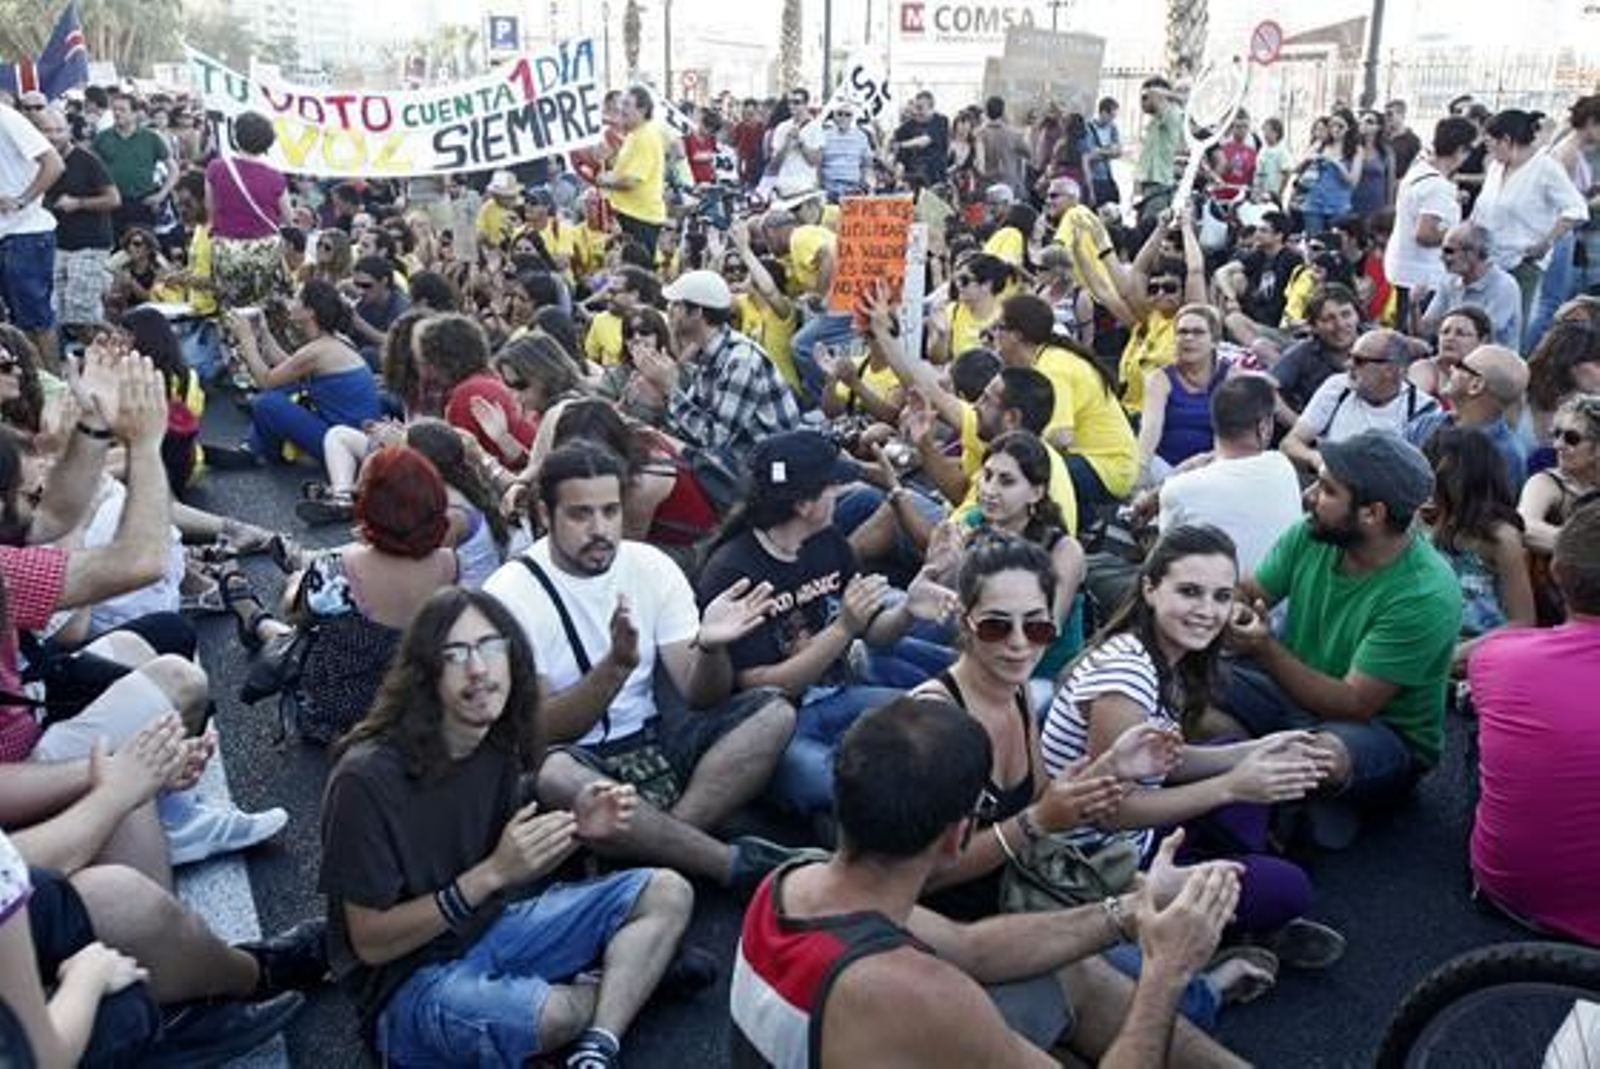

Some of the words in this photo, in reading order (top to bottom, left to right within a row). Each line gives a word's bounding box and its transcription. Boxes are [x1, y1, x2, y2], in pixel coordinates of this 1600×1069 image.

[495, 19, 512, 40] P
[934, 4, 1035, 34] COMSA
[193, 56, 249, 103] TU
[261, 86, 393, 132] VOTO
[402, 82, 516, 127] CUENTA
[508, 58, 536, 102] 1
[273, 116, 412, 172] VOZ
[432, 83, 601, 170] SIEMPRE
